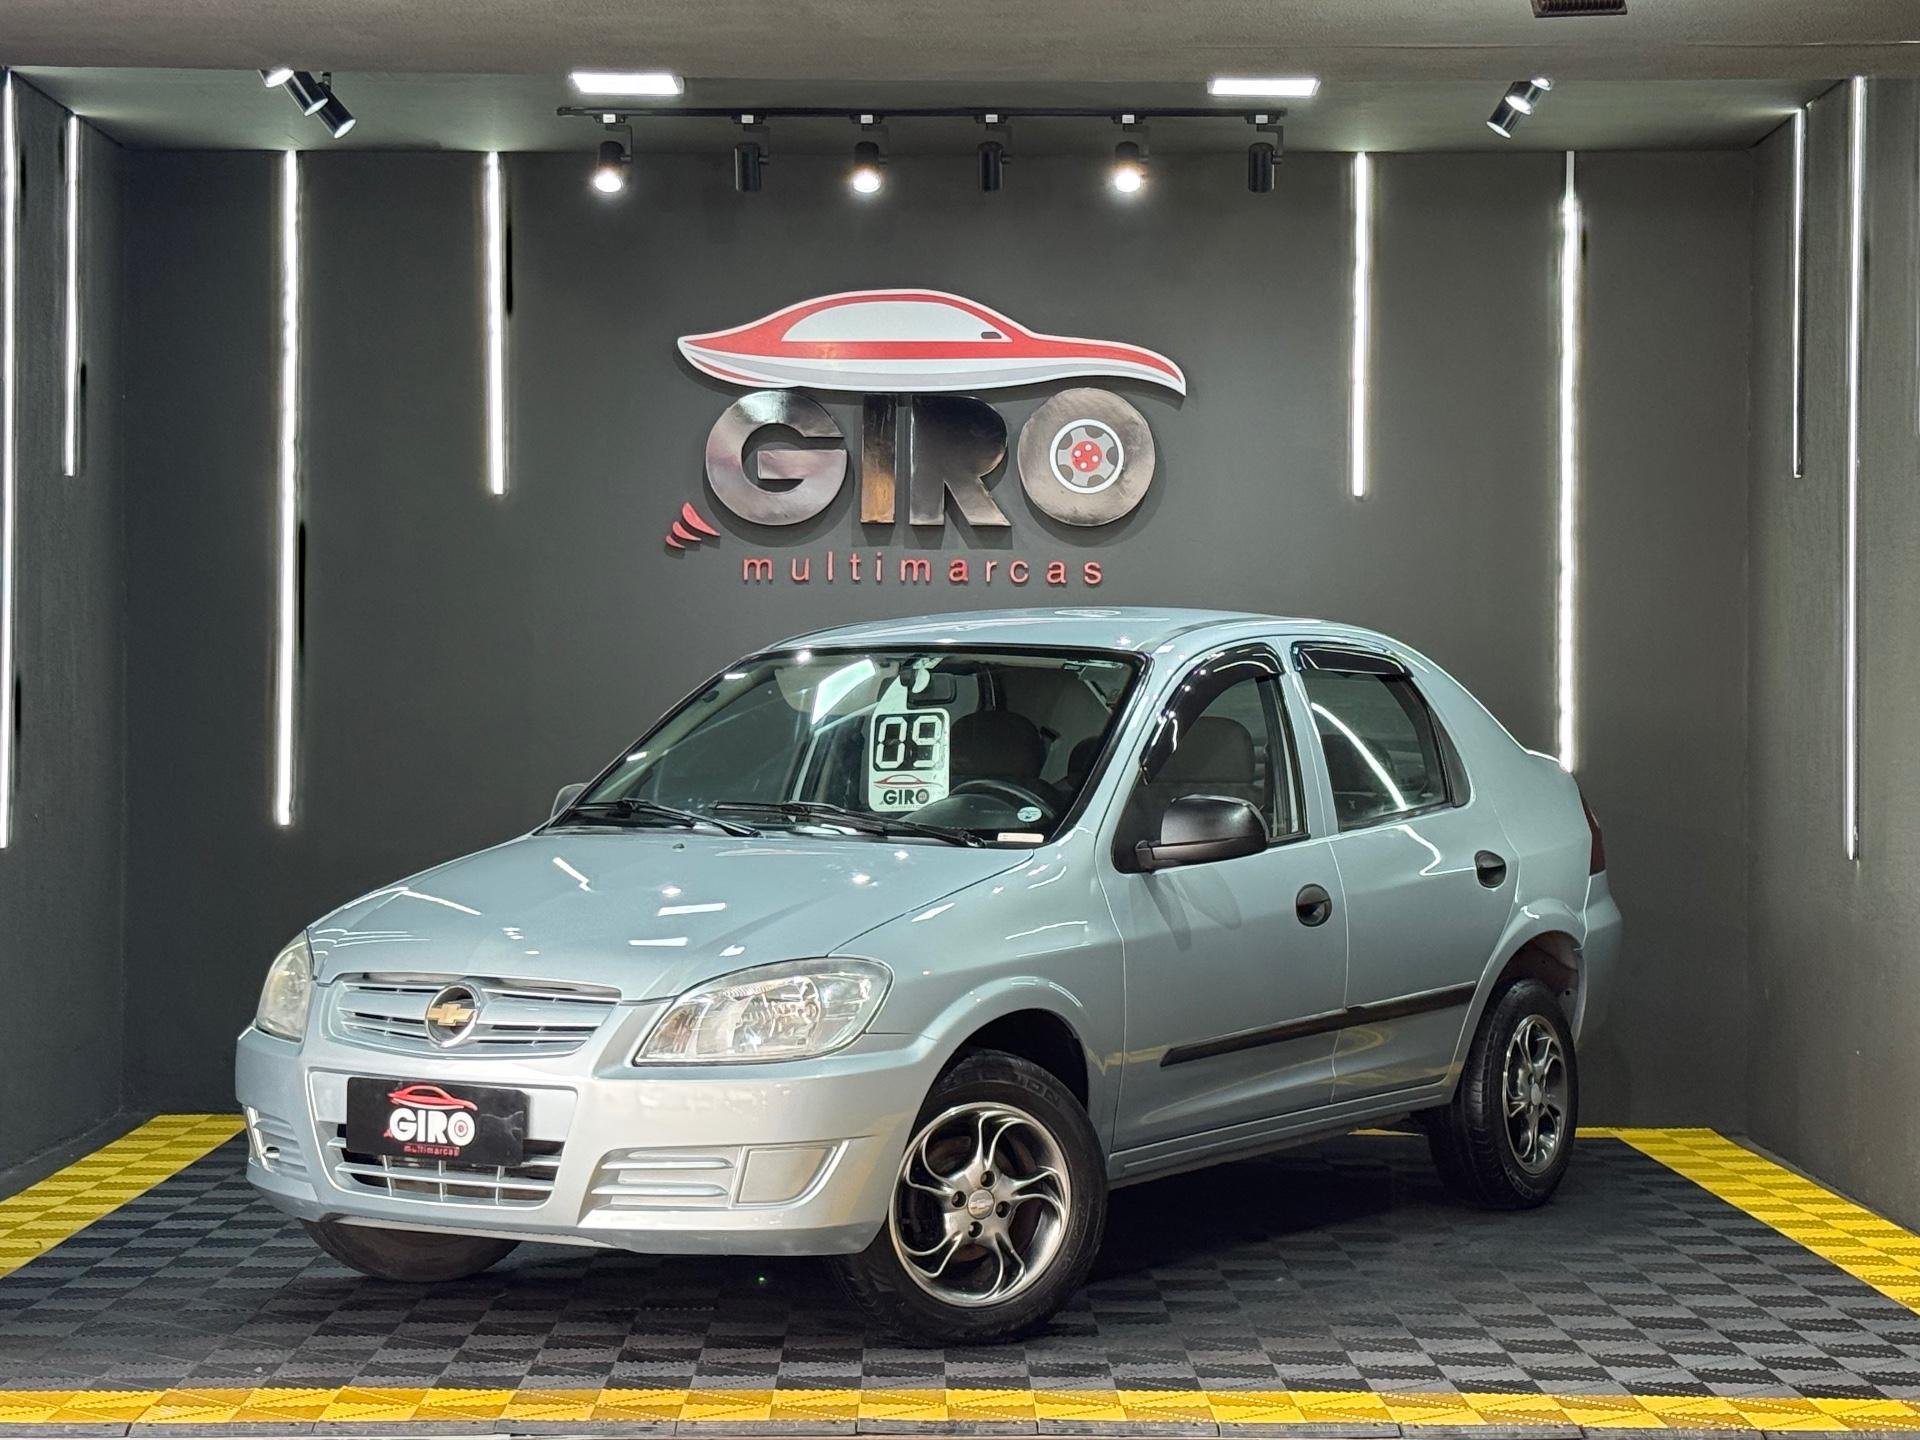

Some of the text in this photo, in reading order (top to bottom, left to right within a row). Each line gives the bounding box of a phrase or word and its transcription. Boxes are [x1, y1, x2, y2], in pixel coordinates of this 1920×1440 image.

[705, 387, 1156, 527] GIRO
[742, 550, 1105, 585] multimarcas
[875, 714, 943, 769] 09
[883, 788, 930, 805] GIRO
[389, 1107, 476, 1146] GIRO
